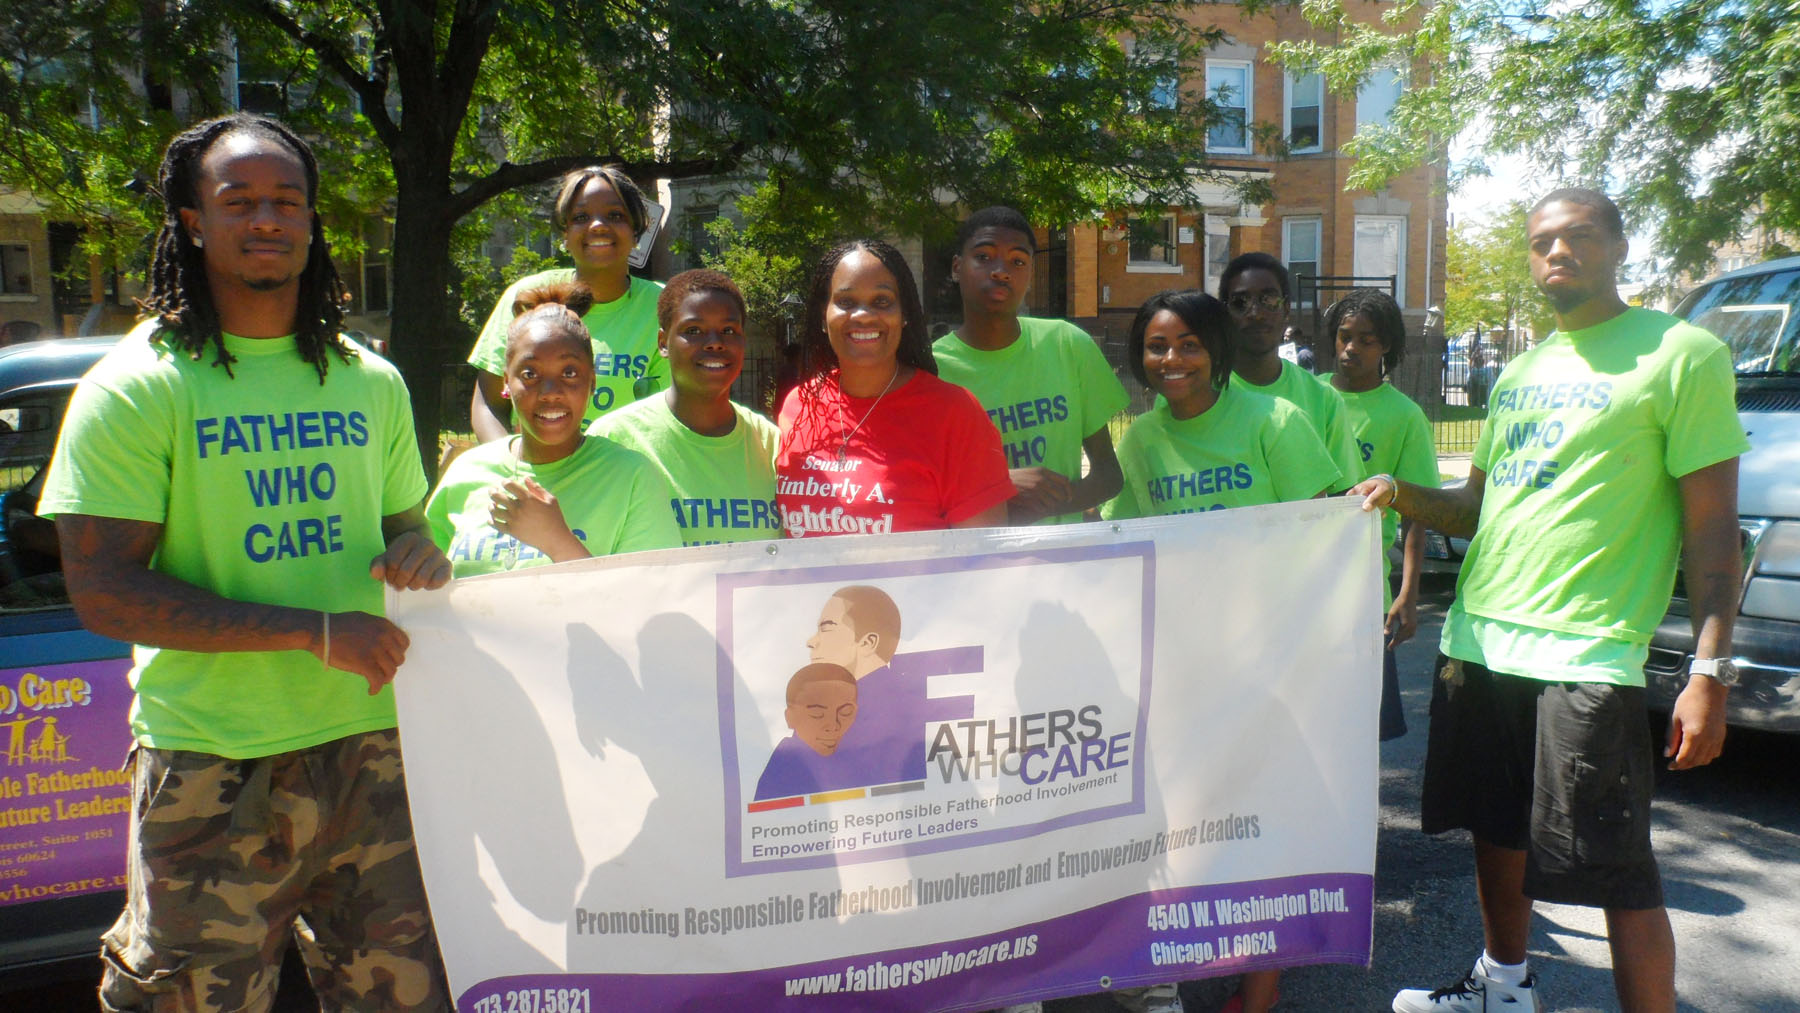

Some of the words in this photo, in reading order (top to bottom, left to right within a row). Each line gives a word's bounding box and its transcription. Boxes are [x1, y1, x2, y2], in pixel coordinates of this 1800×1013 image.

[1495, 382, 1614, 414] FATHERS
[196, 411, 369, 458] FATHERS
[1505, 420, 1564, 450] WHO
[245, 462, 336, 507] WHO
[866, 482, 894, 504] A.
[1147, 463, 1252, 507] FATHERS
[1493, 459, 1559, 489] CARE
[245, 514, 343, 563] CARE
[18, 673, 91, 711] Care
[937, 744, 1024, 784] WHO
[1019, 731, 1132, 786] CARE
[751, 818, 839, 840] Promoting
[844, 802, 942, 830] Responsible
[946, 789, 1033, 816] Fatherhood
[1036, 772, 1118, 799] Involvement
[752, 834, 857, 859] Empowering
[862, 826, 913, 847] Future
[918, 816, 979, 838] Leaders
[575, 907, 680, 938] Promoting
[684, 896, 804, 936] Responsible
[808, 879, 913, 920] Fatherhood
[917, 863, 1022, 906] Involvement
[1025, 857, 1052, 886] and
[1057, 833, 1152, 880] Empowering
[1152, 825, 1197, 855] Future
[1200, 812, 1261, 844] Leaders
[1147, 901, 1189, 931] 4540
[1192, 899, 1214, 928] W.
[1215, 890, 1307, 926] Washington
[1309, 887, 1349, 915] Blvd.
[785, 934, 1039, 997] www.fatherswhocare.us
[1150, 938, 1216, 967] Chicago,
[1218, 936, 1231, 960] IL
[1233, 930, 1277, 958] 60624
